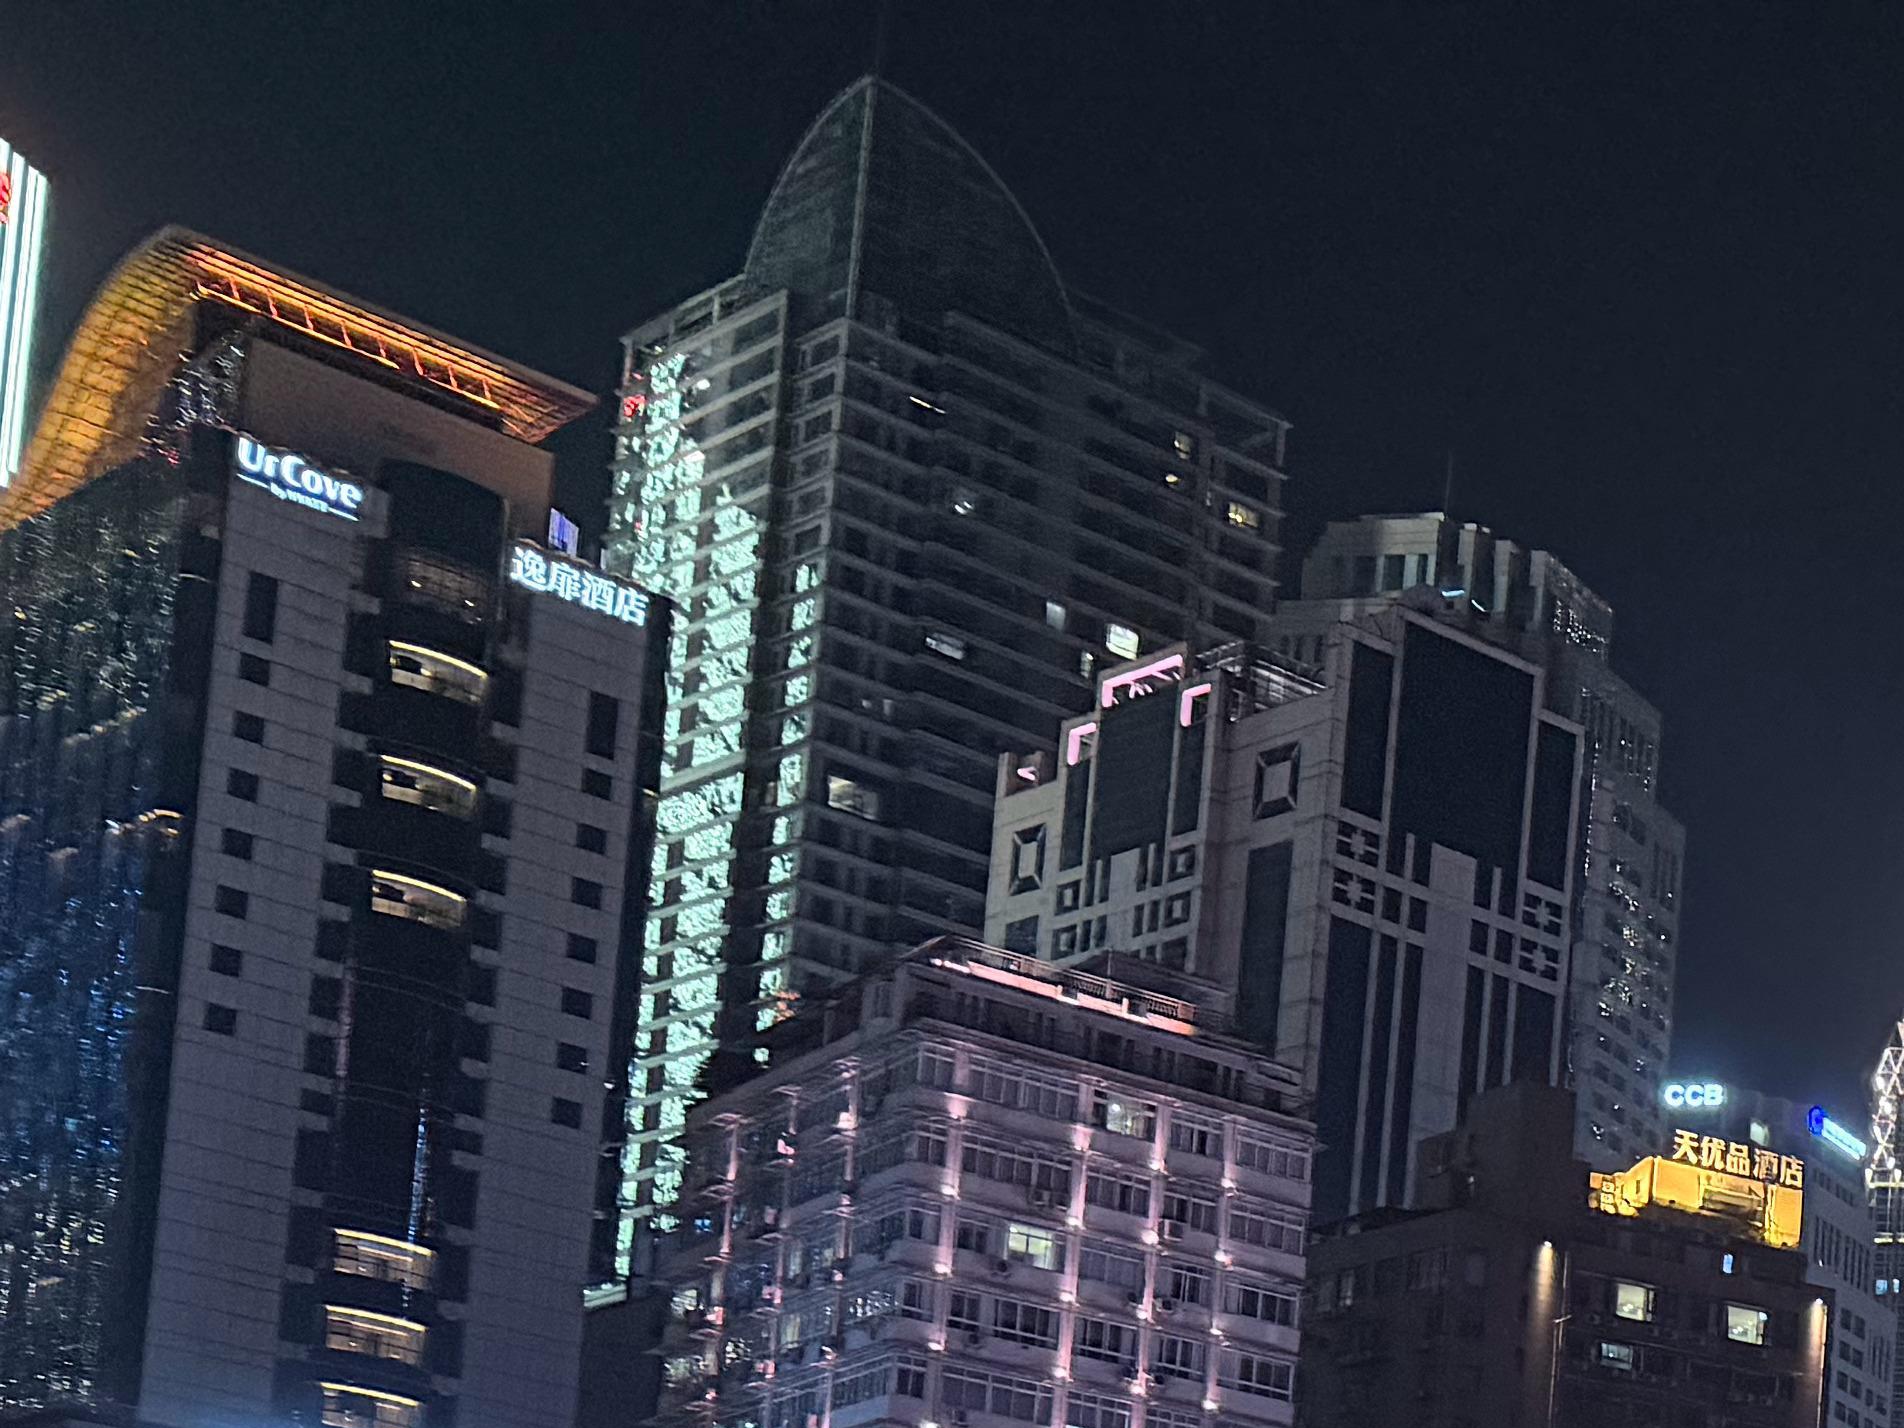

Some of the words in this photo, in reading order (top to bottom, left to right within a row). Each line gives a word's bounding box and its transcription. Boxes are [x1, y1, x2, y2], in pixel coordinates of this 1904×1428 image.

[237, 437, 363, 509] UrCove
[510, 546, 650, 627] 逸扉酒店
[1664, 1084, 1724, 1107] CCB
[1672, 1128, 1805, 1188] 天优品酒店
